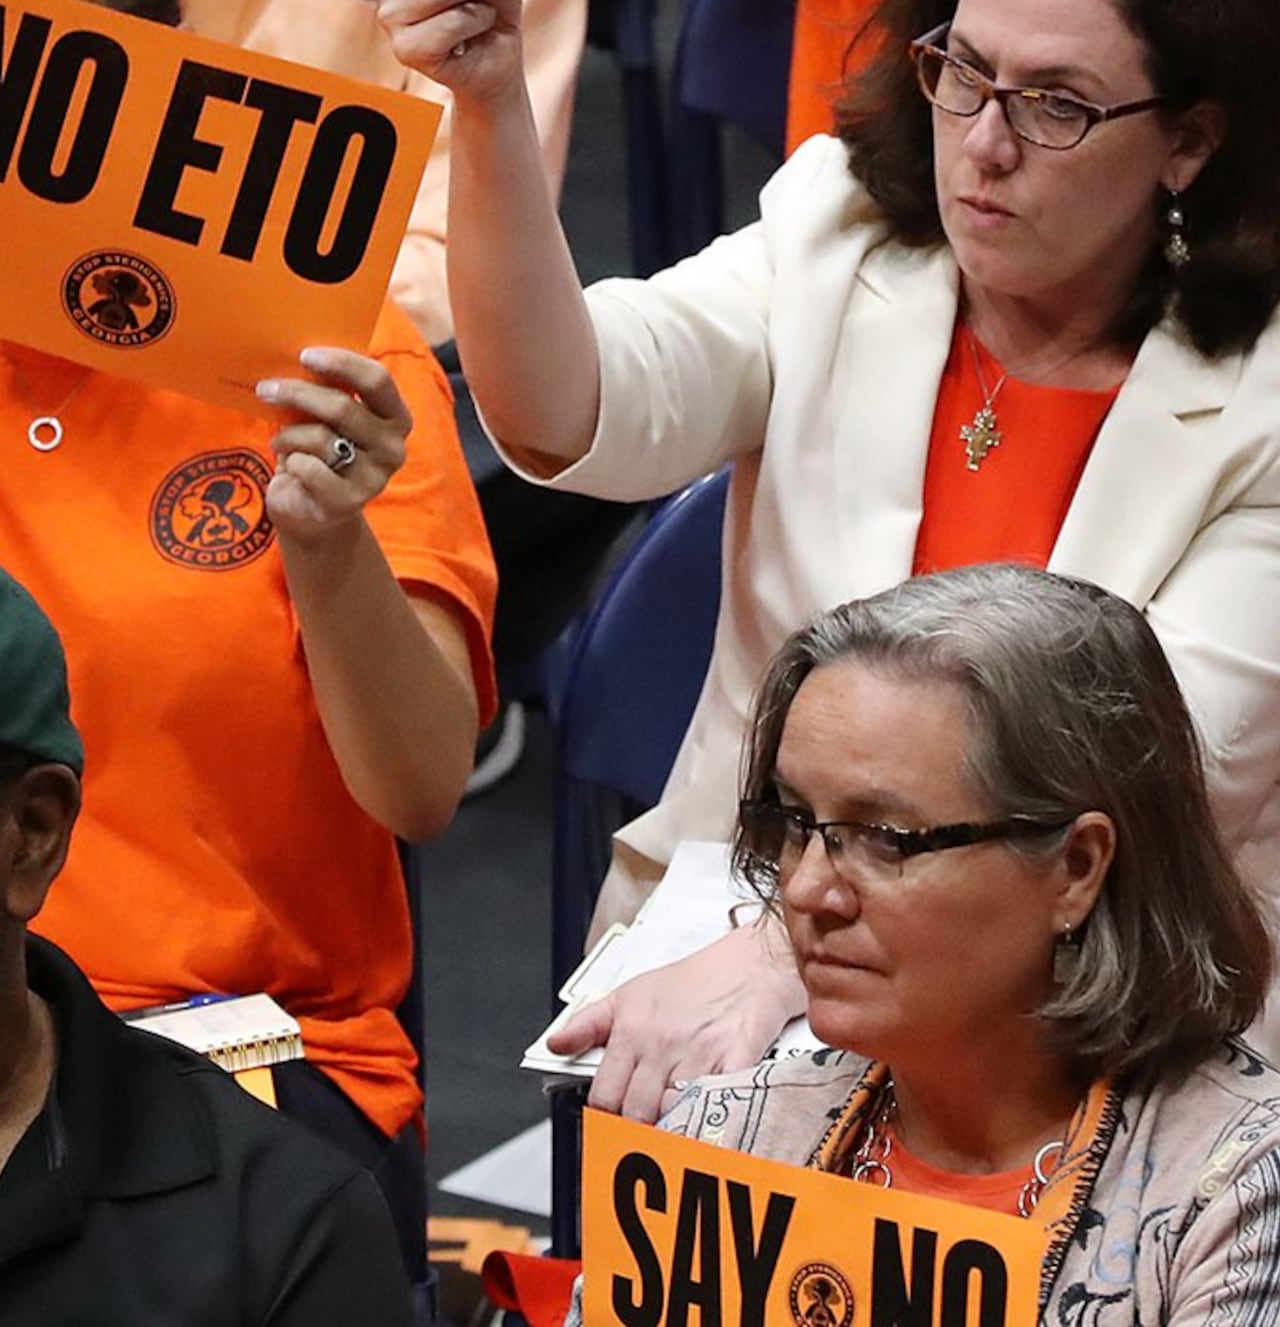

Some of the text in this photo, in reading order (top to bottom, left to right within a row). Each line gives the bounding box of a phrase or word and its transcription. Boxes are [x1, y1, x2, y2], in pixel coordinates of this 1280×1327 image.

[133, 59, 397, 284] ETO
[73, 307, 151, 345] GEORGIA
[171, 531, 266, 563] GEORGIA
[613, 1152, 1007, 1327] SAY NO
